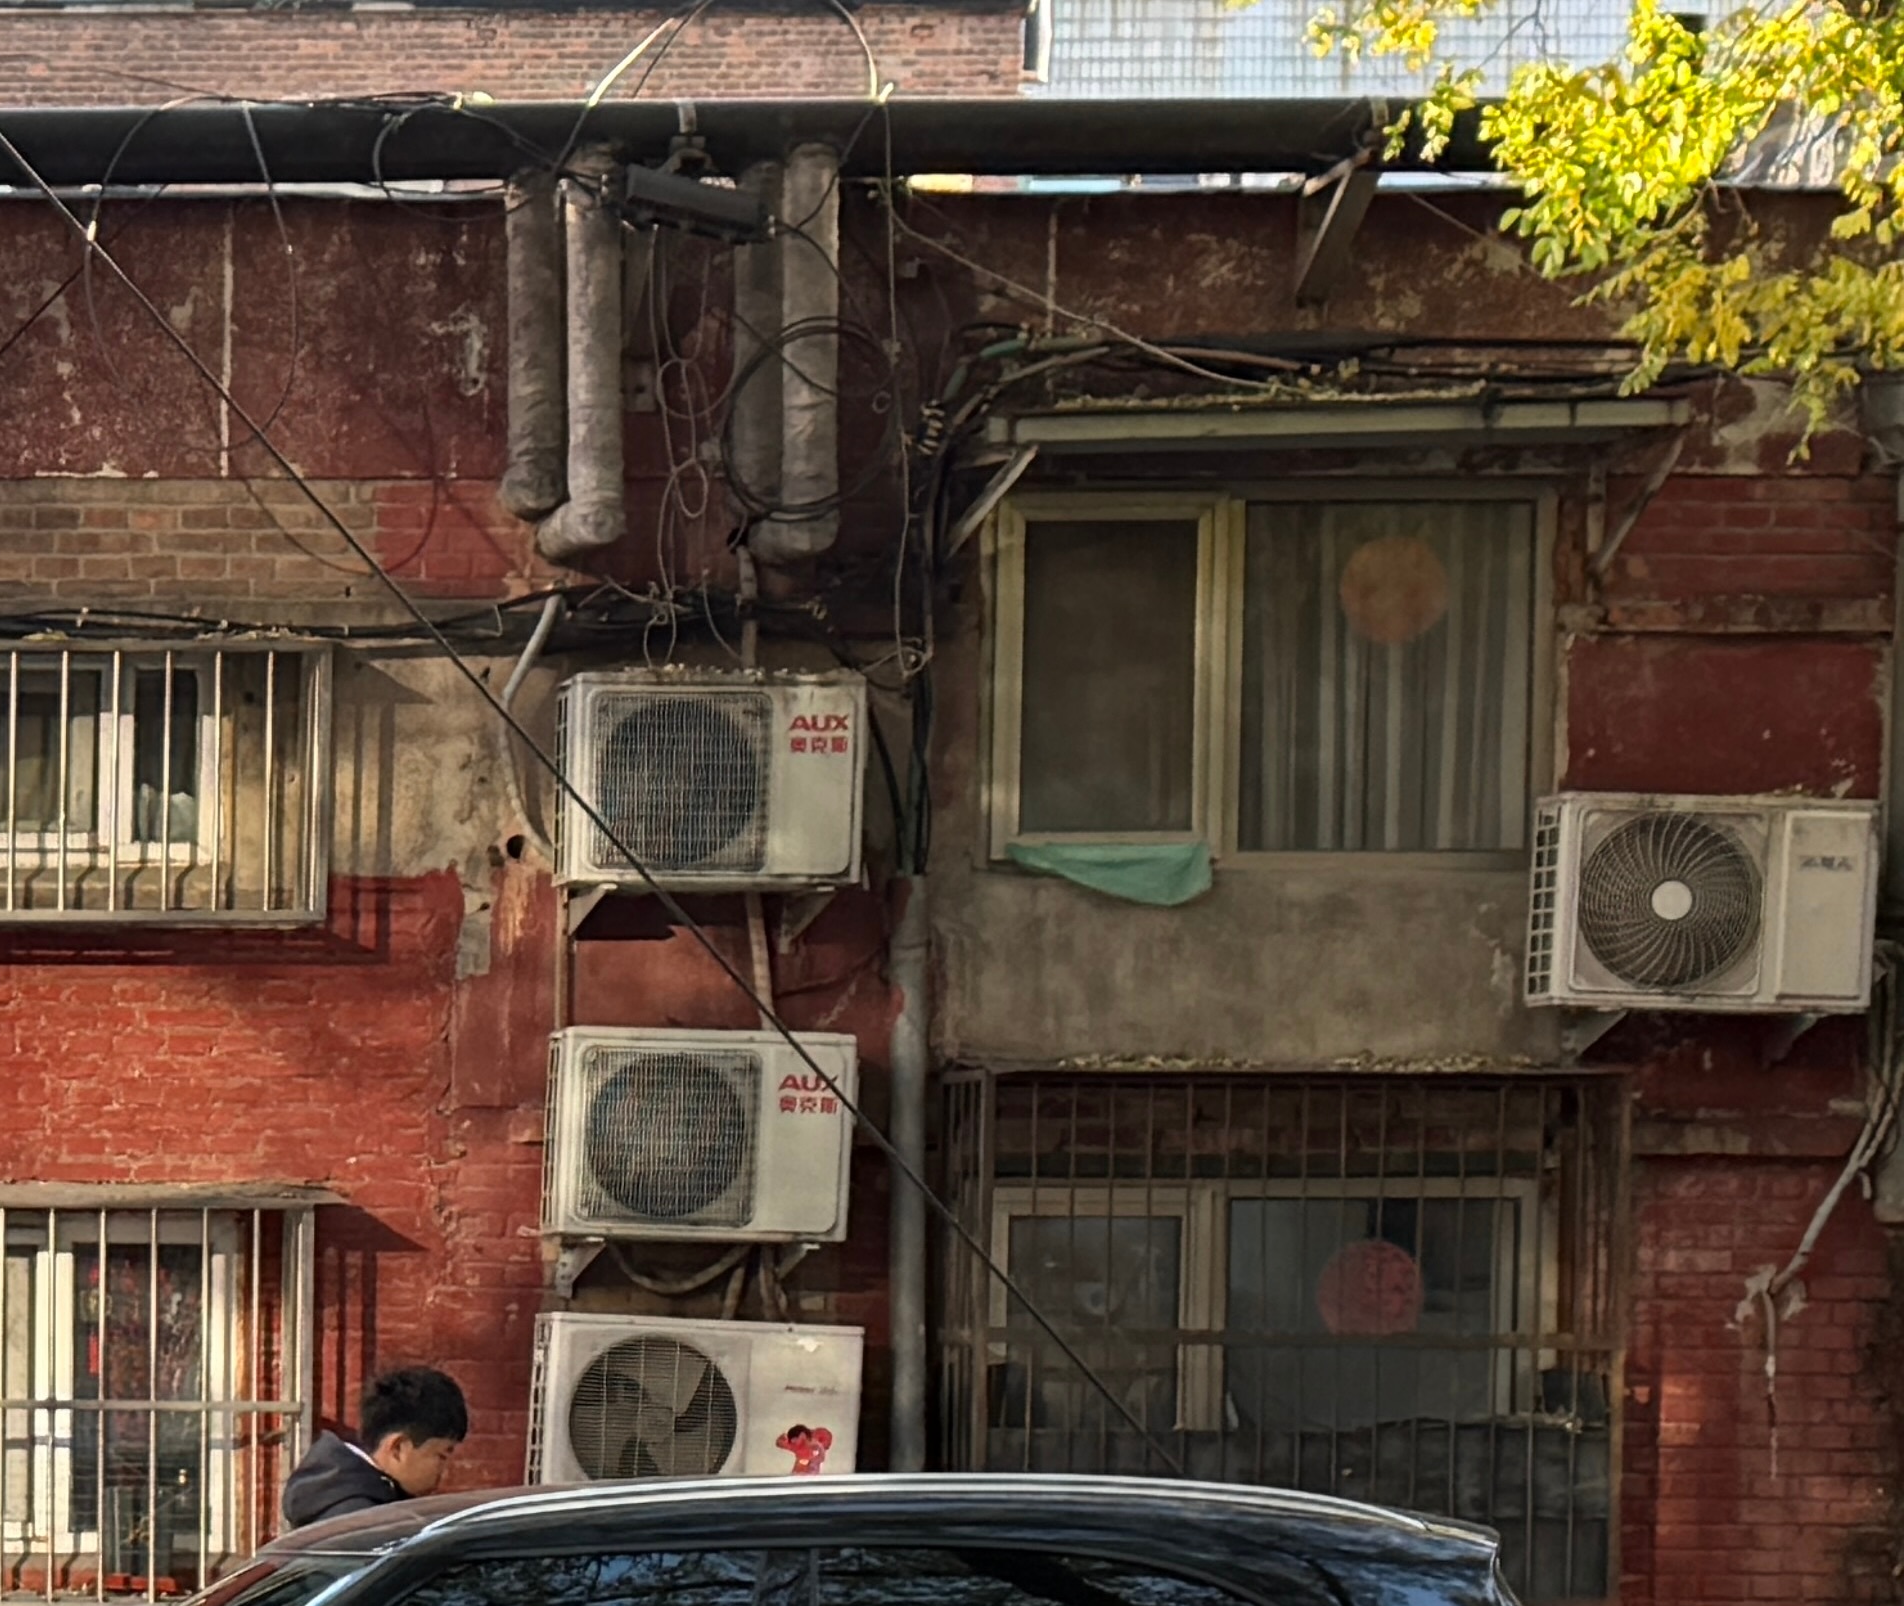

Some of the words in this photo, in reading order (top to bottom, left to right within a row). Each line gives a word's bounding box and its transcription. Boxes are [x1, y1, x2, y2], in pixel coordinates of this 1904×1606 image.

[789, 714, 849, 732] AUX
[779, 1096, 838, 1114] 奥克斯
